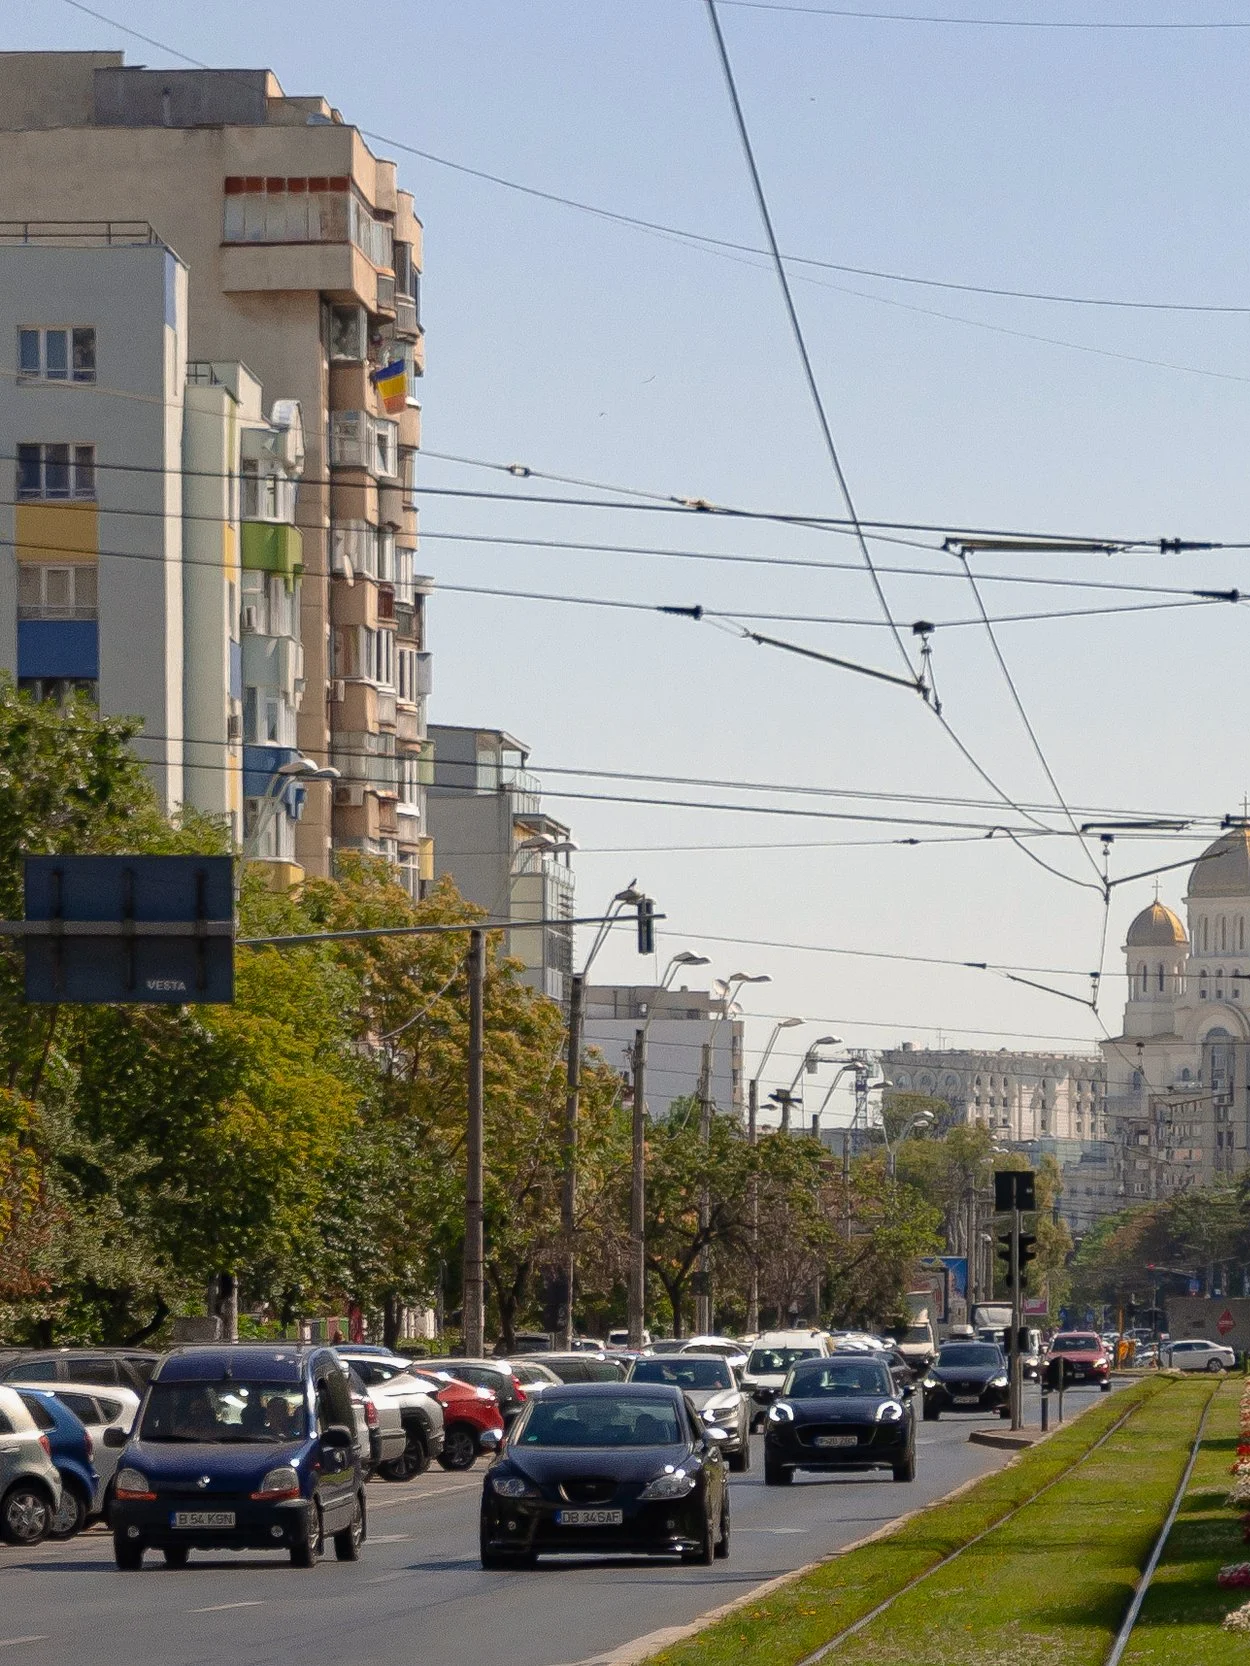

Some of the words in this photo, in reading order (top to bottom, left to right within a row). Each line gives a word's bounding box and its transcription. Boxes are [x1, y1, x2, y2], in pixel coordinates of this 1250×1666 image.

[146, 980, 186, 991] VESTA
[178, 1514, 187, 1525] B
[190, 1514, 204, 1525] 54
[562, 1512, 579, 1523] DB
[583, 1511, 596, 1523] 34
